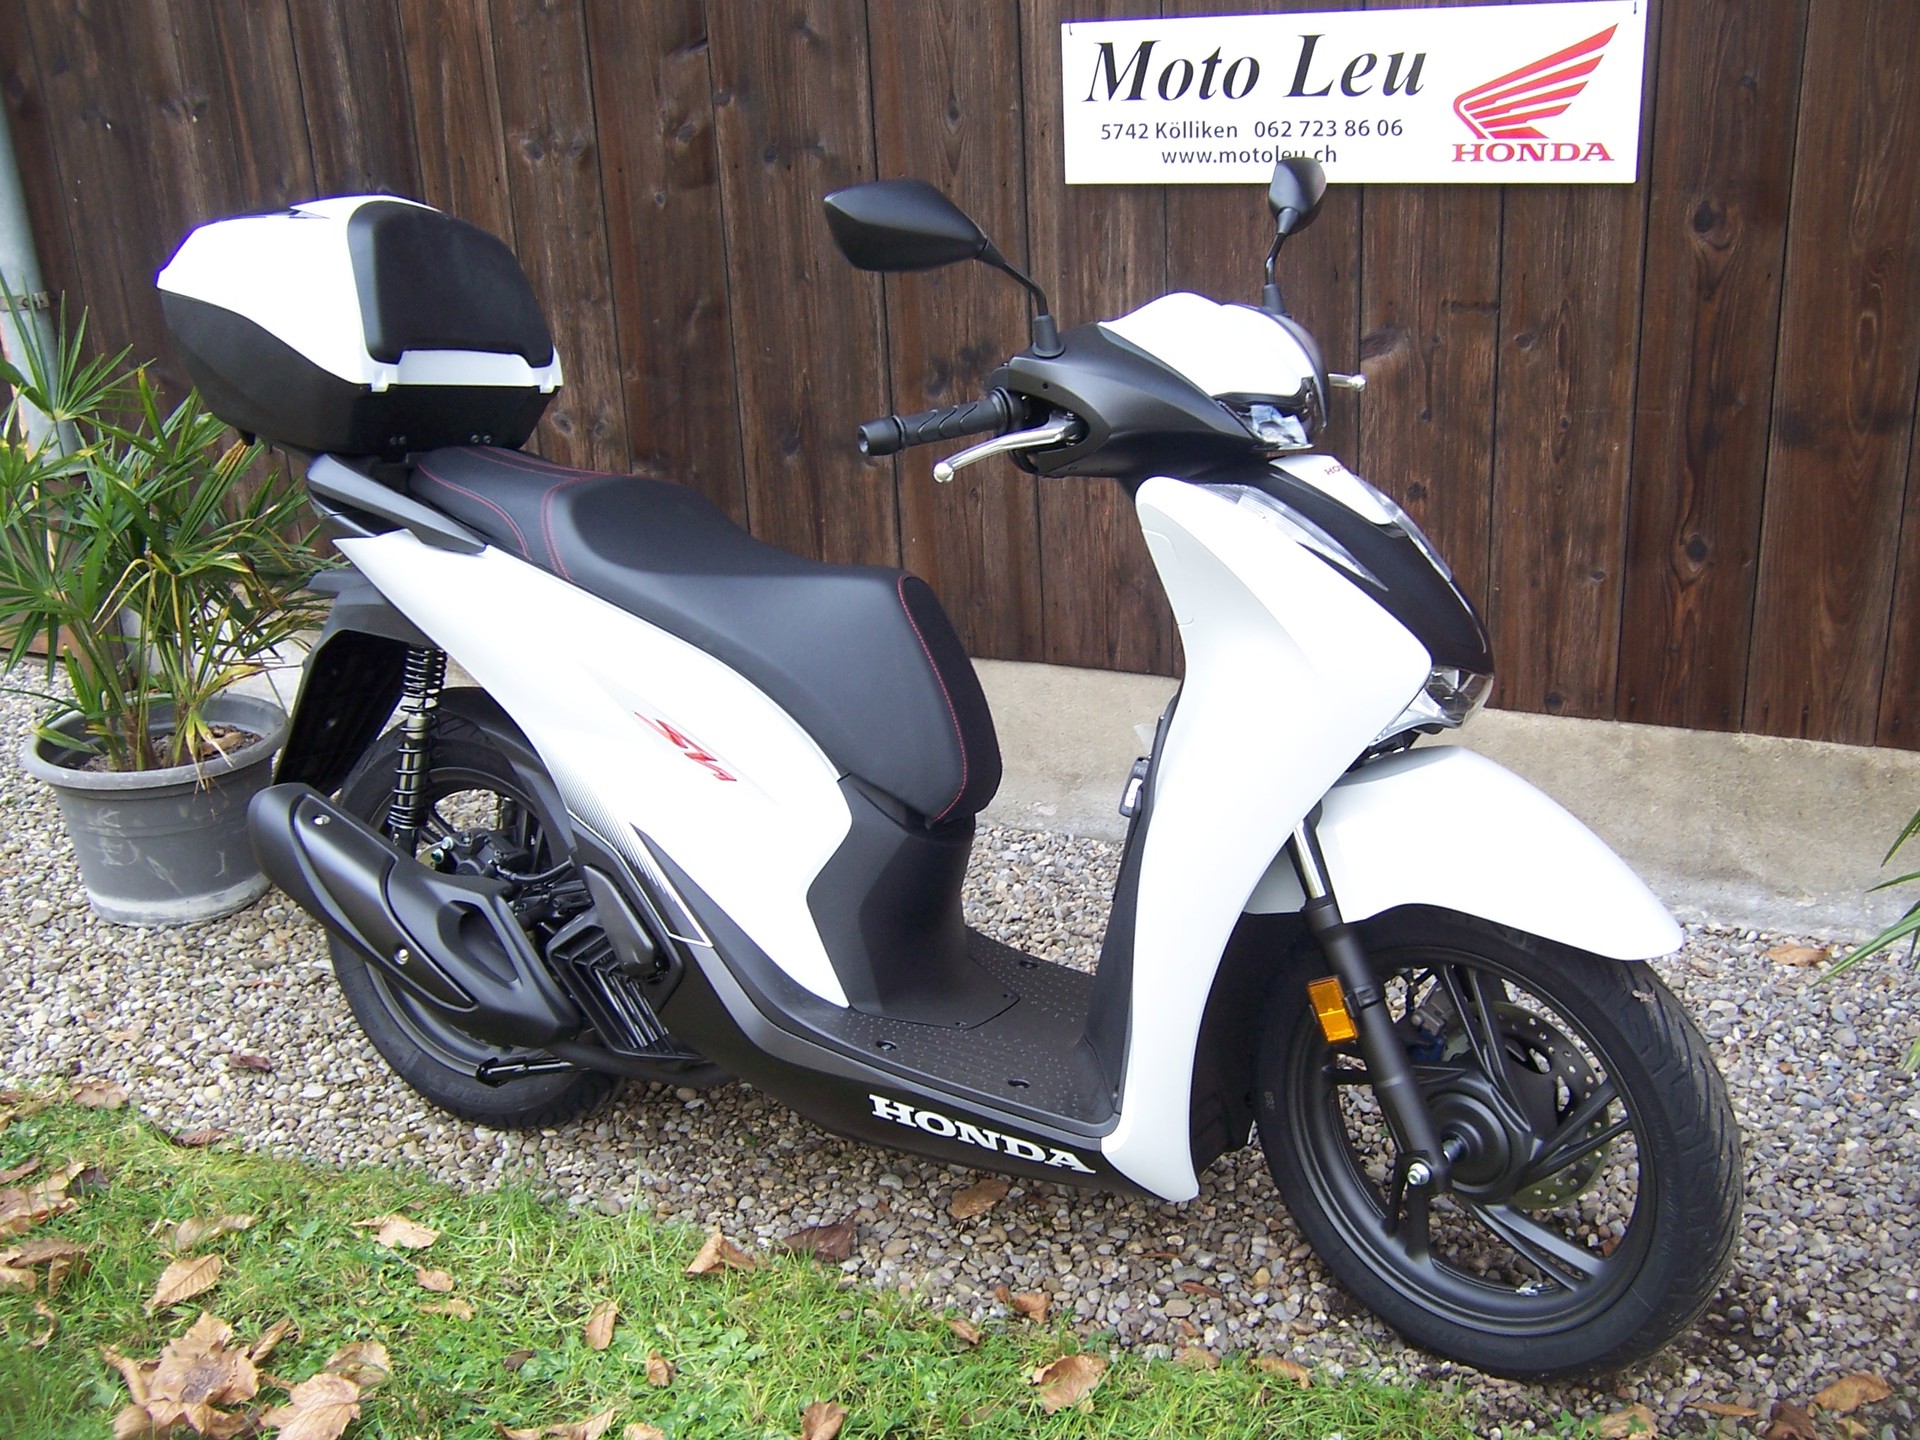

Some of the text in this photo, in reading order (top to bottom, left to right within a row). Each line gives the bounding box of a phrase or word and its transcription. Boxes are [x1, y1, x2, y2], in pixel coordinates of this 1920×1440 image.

[1082, 33, 1427, 102] Moto Leu
[1101, 118, 1403, 140] 5742 Kölliken 062 723 86 06
[1162, 144, 1337, 163] www.motoleuch
[1452, 142, 1615, 162] HONDA
[869, 1093, 1097, 1174] HONDA
